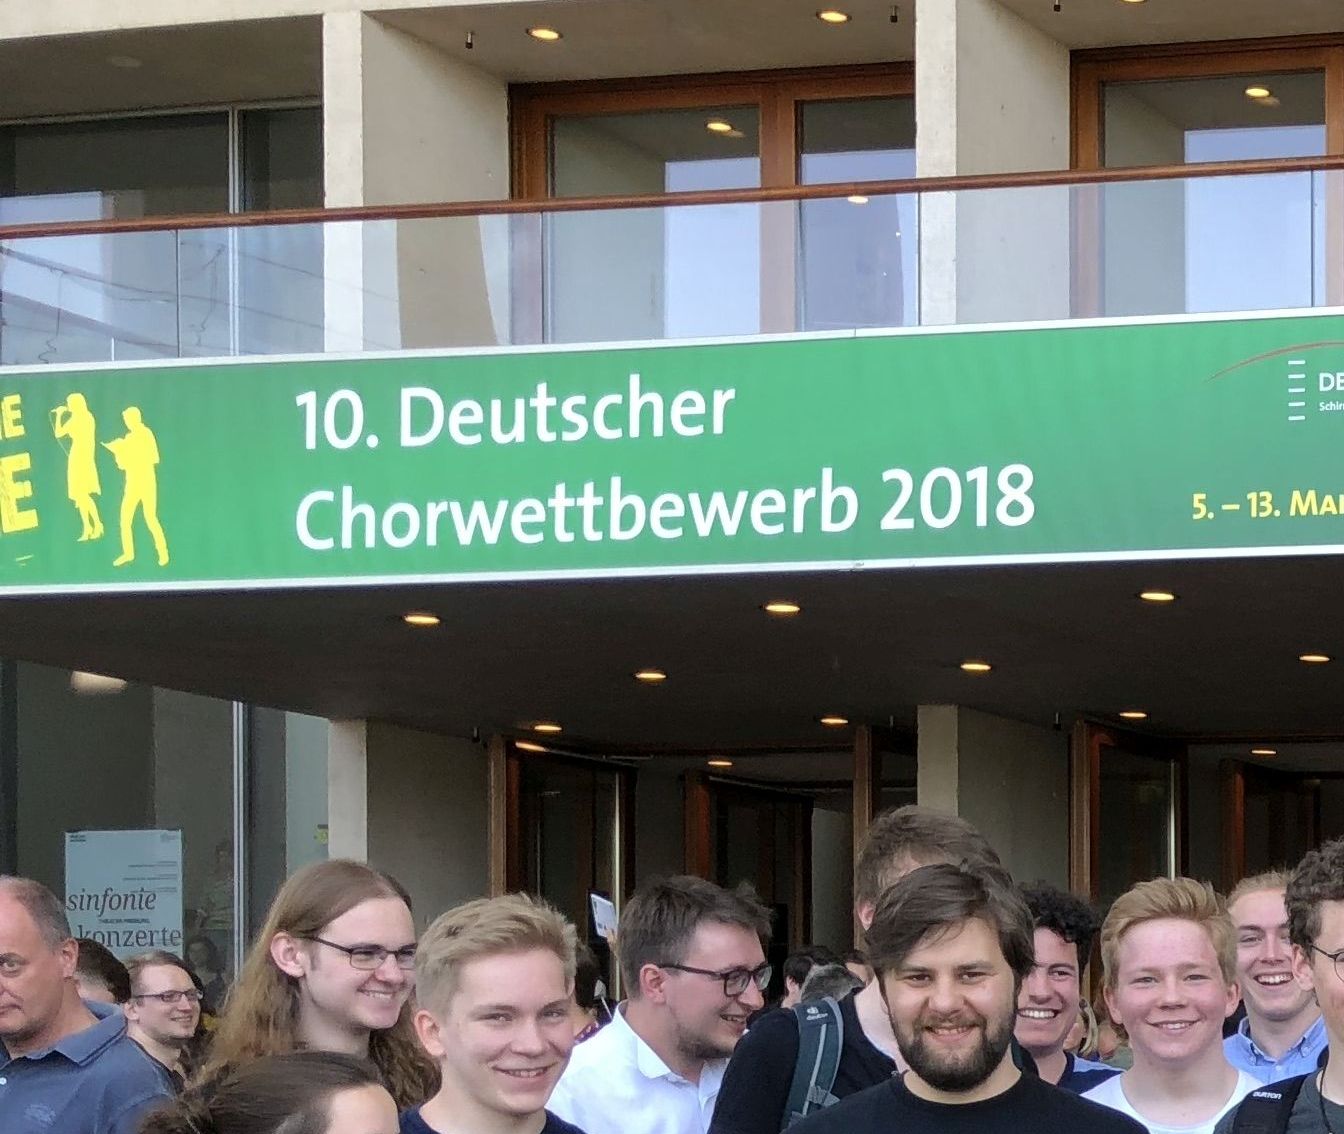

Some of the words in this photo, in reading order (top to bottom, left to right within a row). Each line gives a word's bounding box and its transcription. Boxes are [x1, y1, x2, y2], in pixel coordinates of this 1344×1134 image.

[295, 388, 380, 451] 10.
[400, 374, 736, 448] Deutscher
[295, 467, 859, 551] Chorwettbewerb
[880, 464, 1036, 531] 2018
[1192, 492, 1215, 521] 5.
[1246, 490, 1282, 519] 13.
[66, 886, 157, 918] sinfonie
